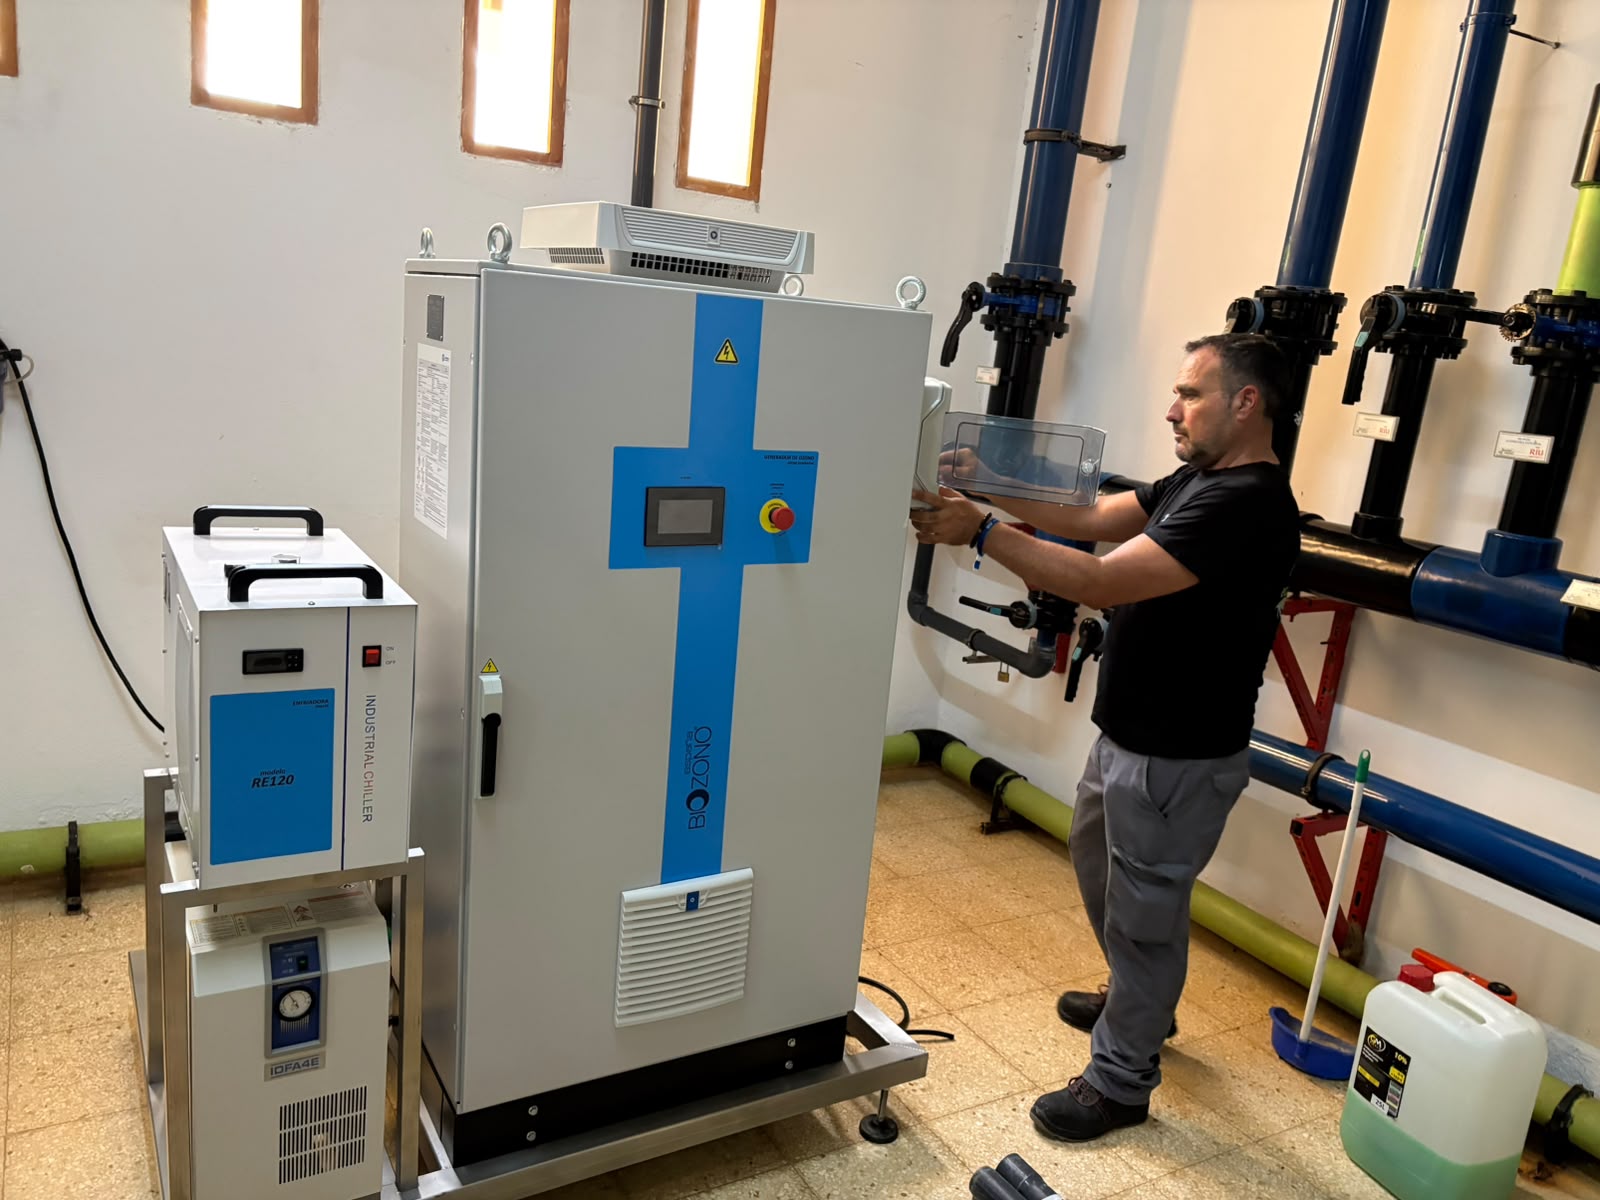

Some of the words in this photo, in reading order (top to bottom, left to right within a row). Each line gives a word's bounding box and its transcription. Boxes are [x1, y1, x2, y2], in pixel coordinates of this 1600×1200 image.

[1529, 448, 1544, 456] RIU
[364, 694, 376, 769] INDUSTRIAL
[252, 774, 295, 789] RE120
[686, 726, 712, 829] BIOZONO
[362, 770, 374, 823] CHILLER
[270, 1057, 320, 1076] IDFA4E
[1375, 1098, 1386, 1110] 25L
